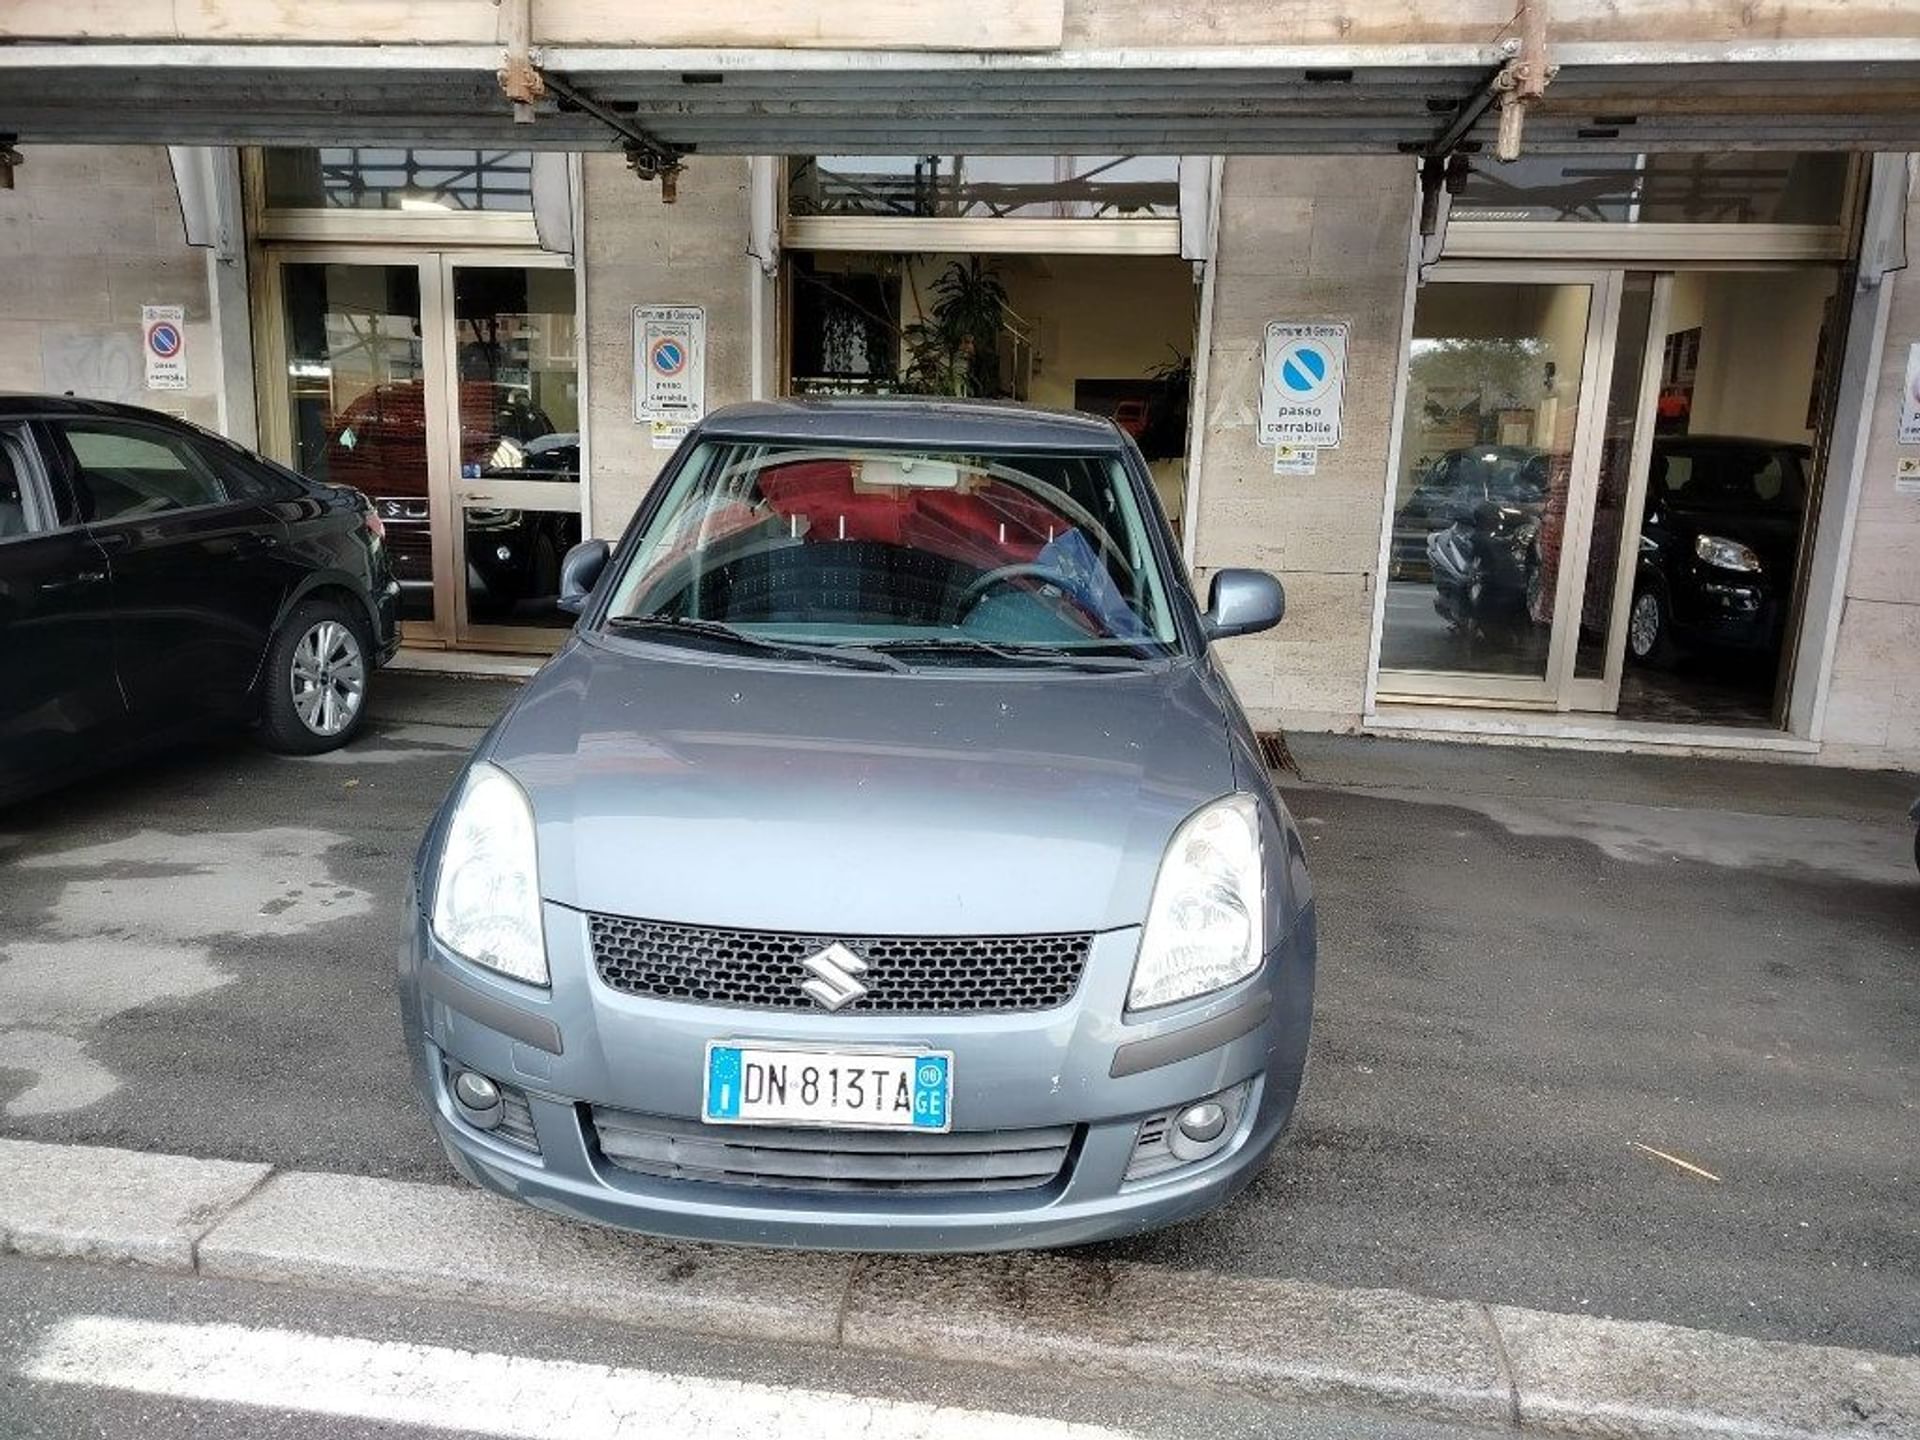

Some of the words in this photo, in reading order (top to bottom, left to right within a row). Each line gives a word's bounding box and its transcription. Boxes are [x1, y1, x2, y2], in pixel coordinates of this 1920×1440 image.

[1278, 406, 1322, 418] passo
[1267, 422, 1331, 433] carrabile
[916, 1090, 940, 1116] GE
